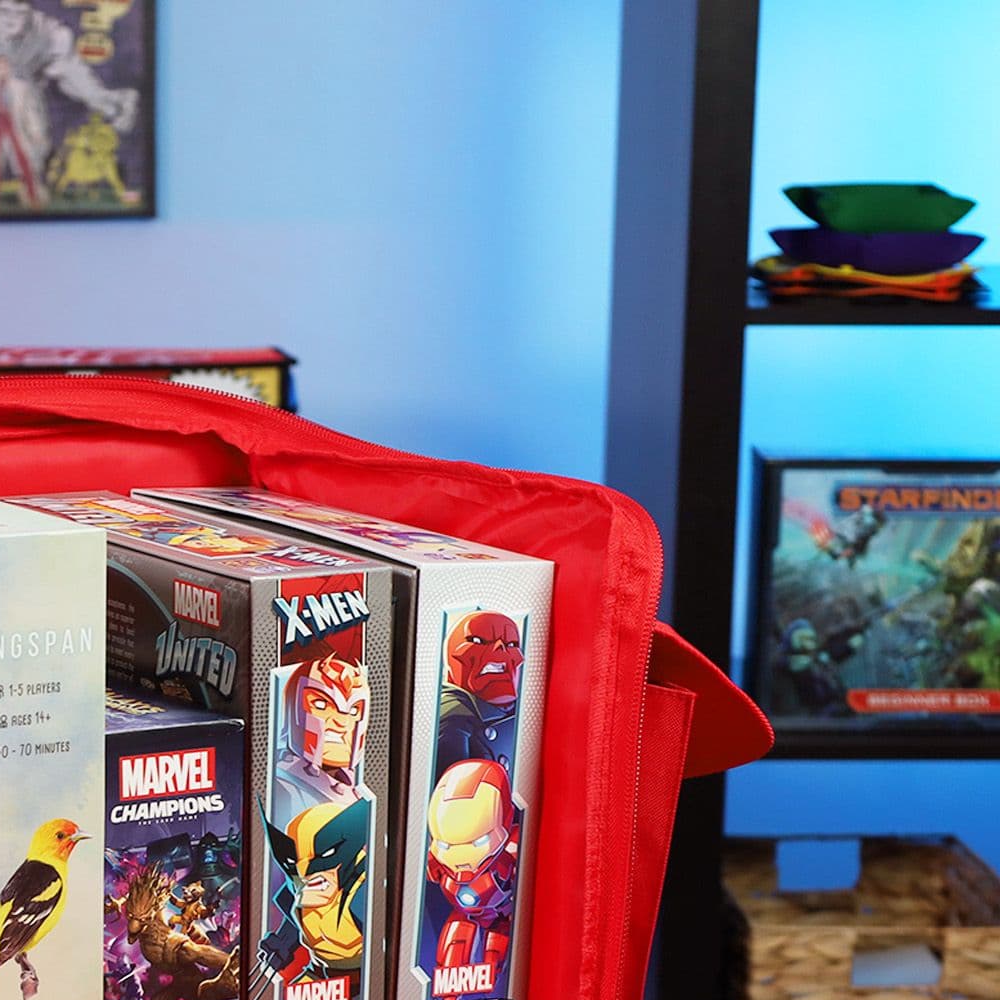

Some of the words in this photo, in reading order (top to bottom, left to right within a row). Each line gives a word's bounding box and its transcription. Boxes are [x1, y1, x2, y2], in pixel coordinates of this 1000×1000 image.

[839, 486, 1000, 513] STARFIND
[174, 580, 221, 628] MARVEL
[272, 590, 371, 650] X-MEN
[156, 620, 238, 697] UNITED
[9, 683, 24, 697] 1-5
[26, 681, 62, 696] PLAYERS
[11, 714, 32, 727] AGES
[35, 711, 51, 724] 14+
[20, 742, 33, 757] 70
[35, 740, 71, 755] MINUTES
[121, 751, 213, 798] MARVEL
[110, 793, 225, 824] CHAMPIONS
[434, 964, 492, 995] MARVEL
